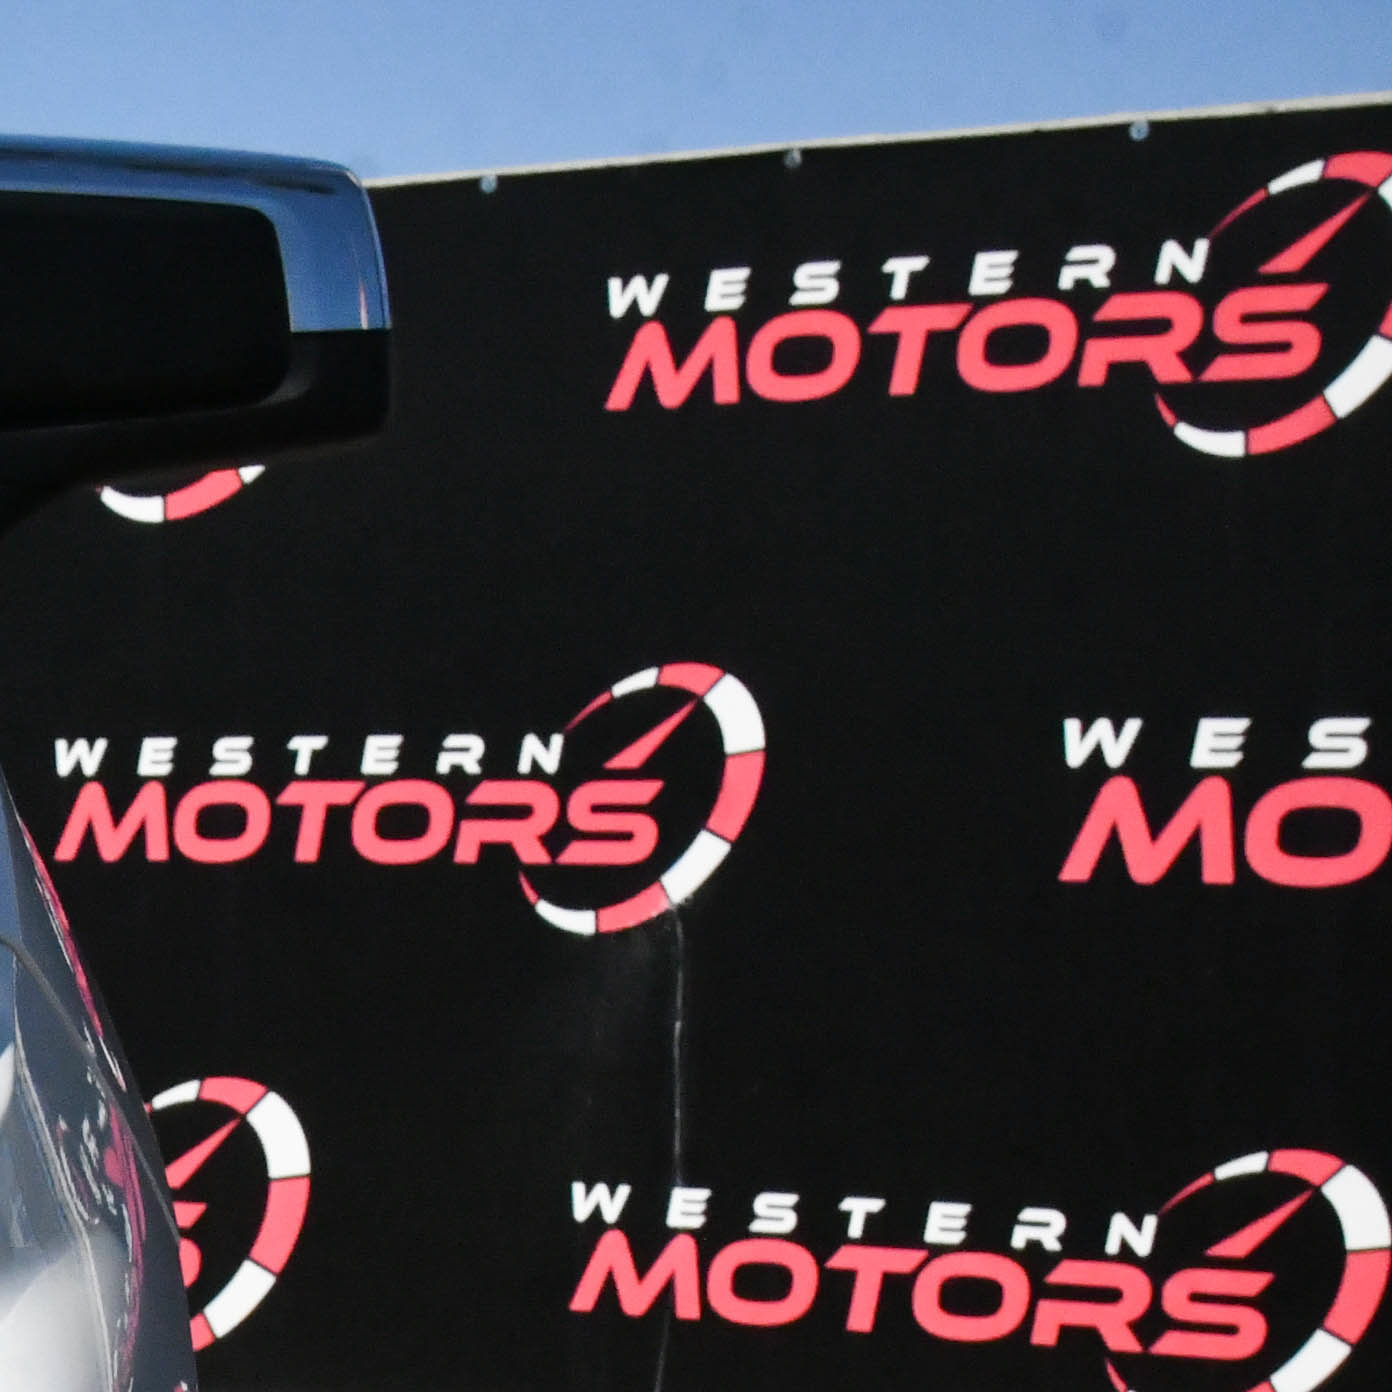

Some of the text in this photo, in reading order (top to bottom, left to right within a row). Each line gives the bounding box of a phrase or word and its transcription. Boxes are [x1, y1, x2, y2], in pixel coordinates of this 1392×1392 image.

[608, 238, 1210, 319] WESTERN
[605, 283, 1328, 411] MOTORS
[54, 733, 564, 777] WESTERN
[54, 779, 664, 865] MOTORS
[571, 1181, 1158, 1258] WESTERN
[569, 1228, 1274, 1361] MOTORS
